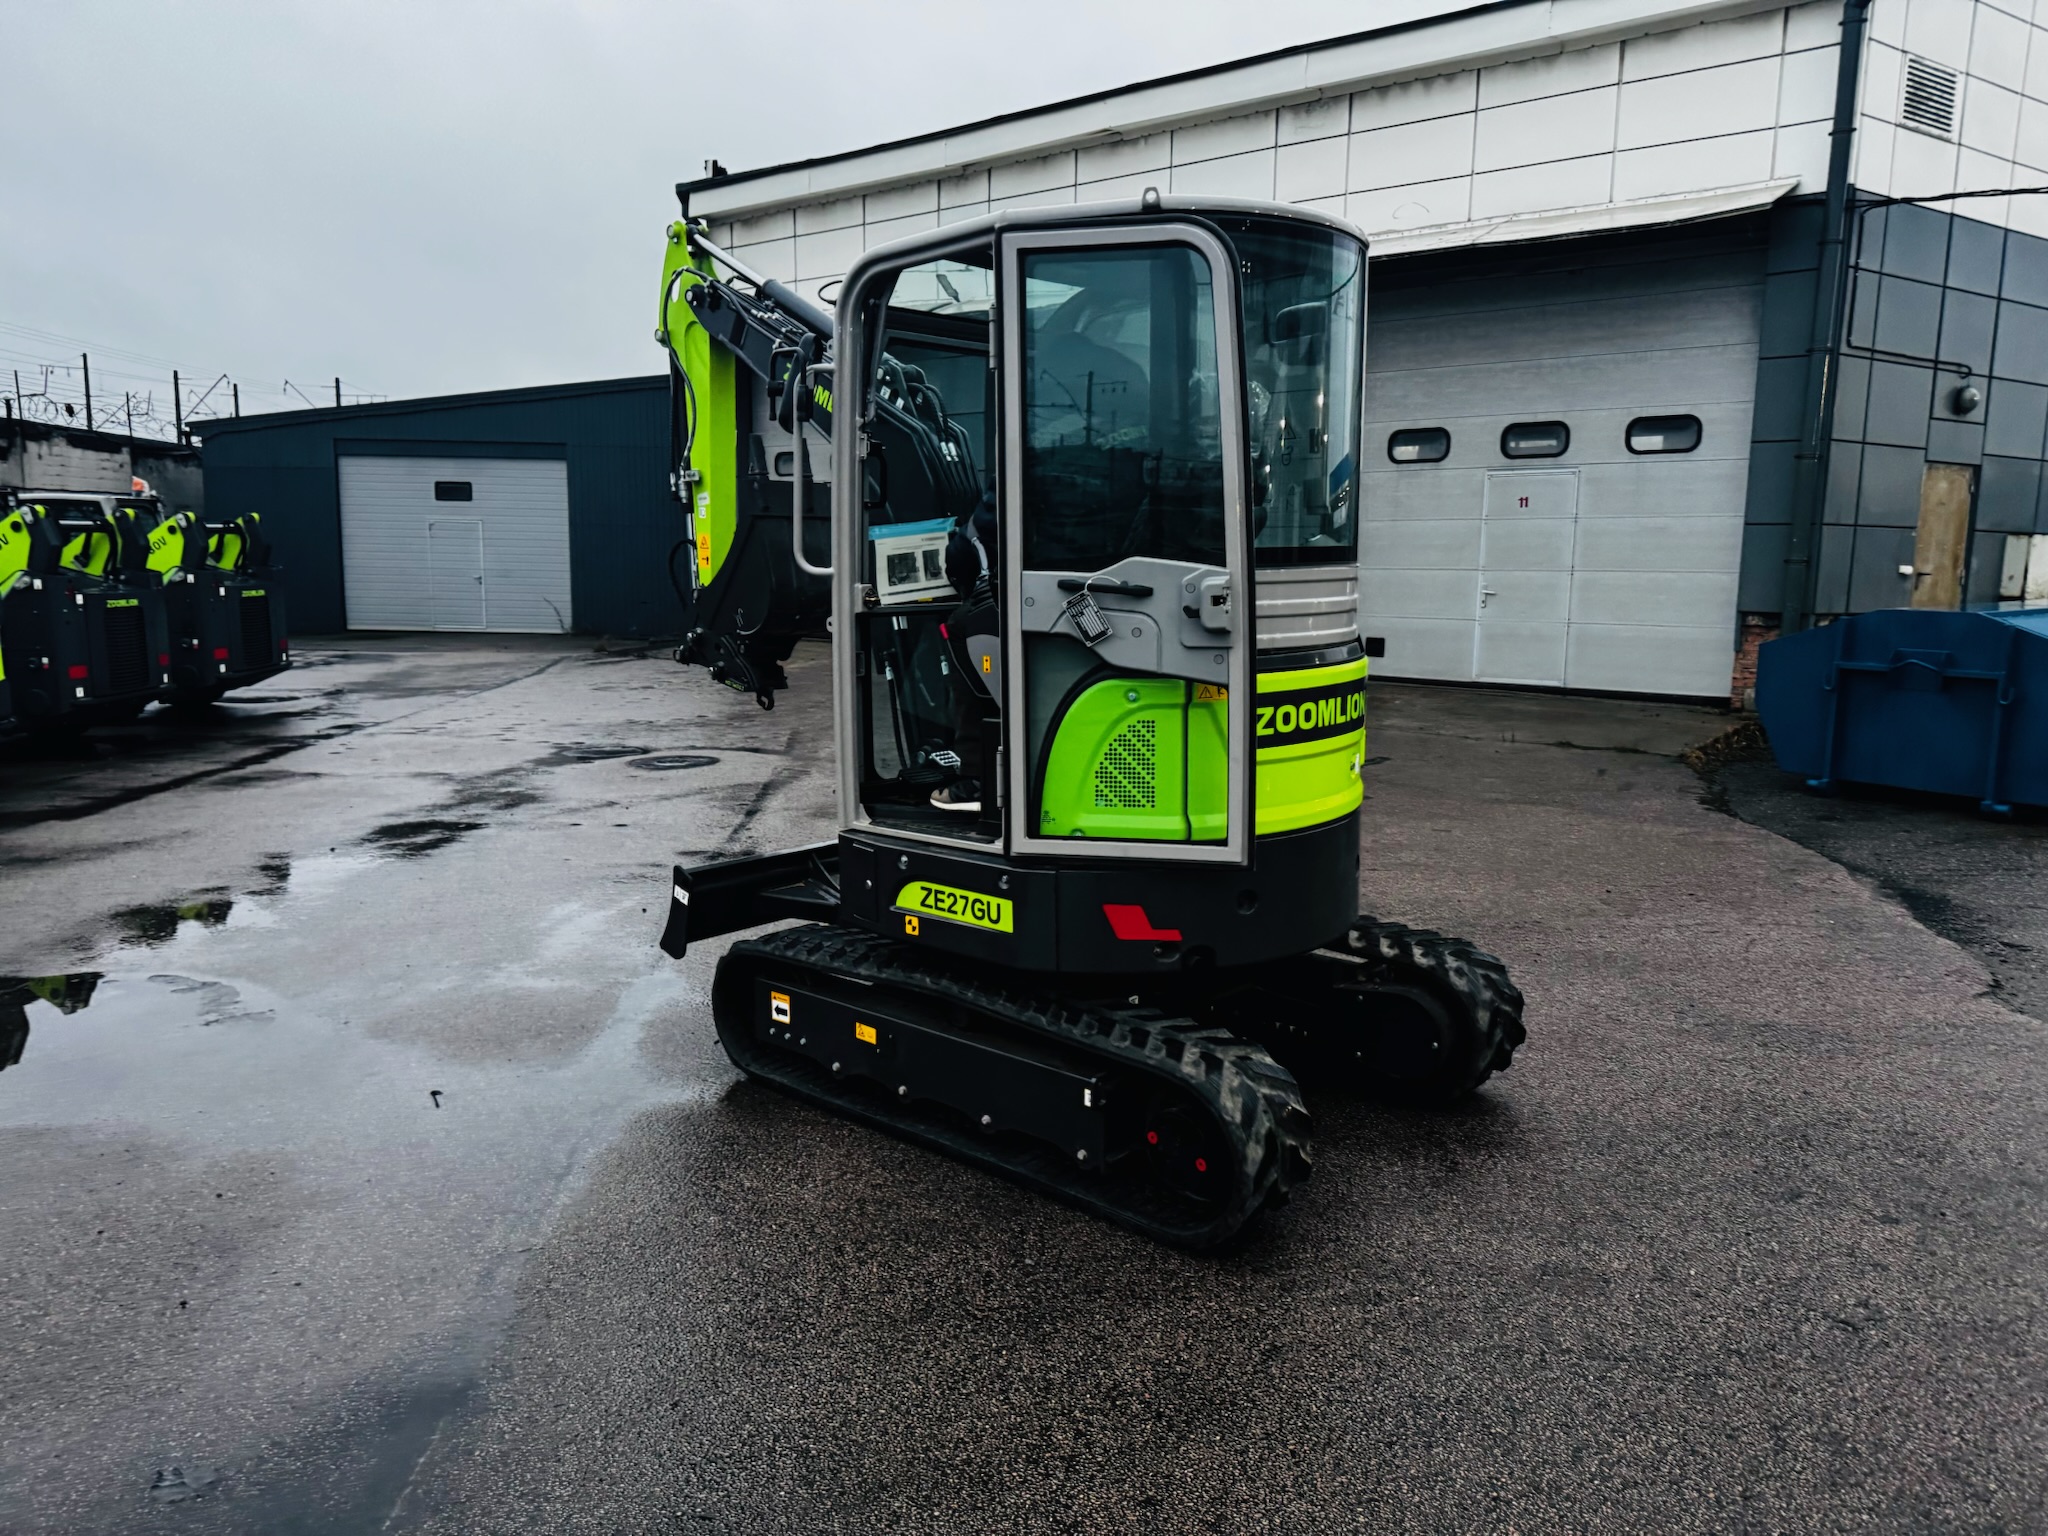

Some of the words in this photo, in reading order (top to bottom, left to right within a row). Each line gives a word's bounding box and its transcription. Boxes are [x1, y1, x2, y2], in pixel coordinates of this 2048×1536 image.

[1518, 496, 1529, 508] 11
[1256, 690, 1366, 736] ZOOMLION
[920, 886, 1001, 925] ZE27GU
